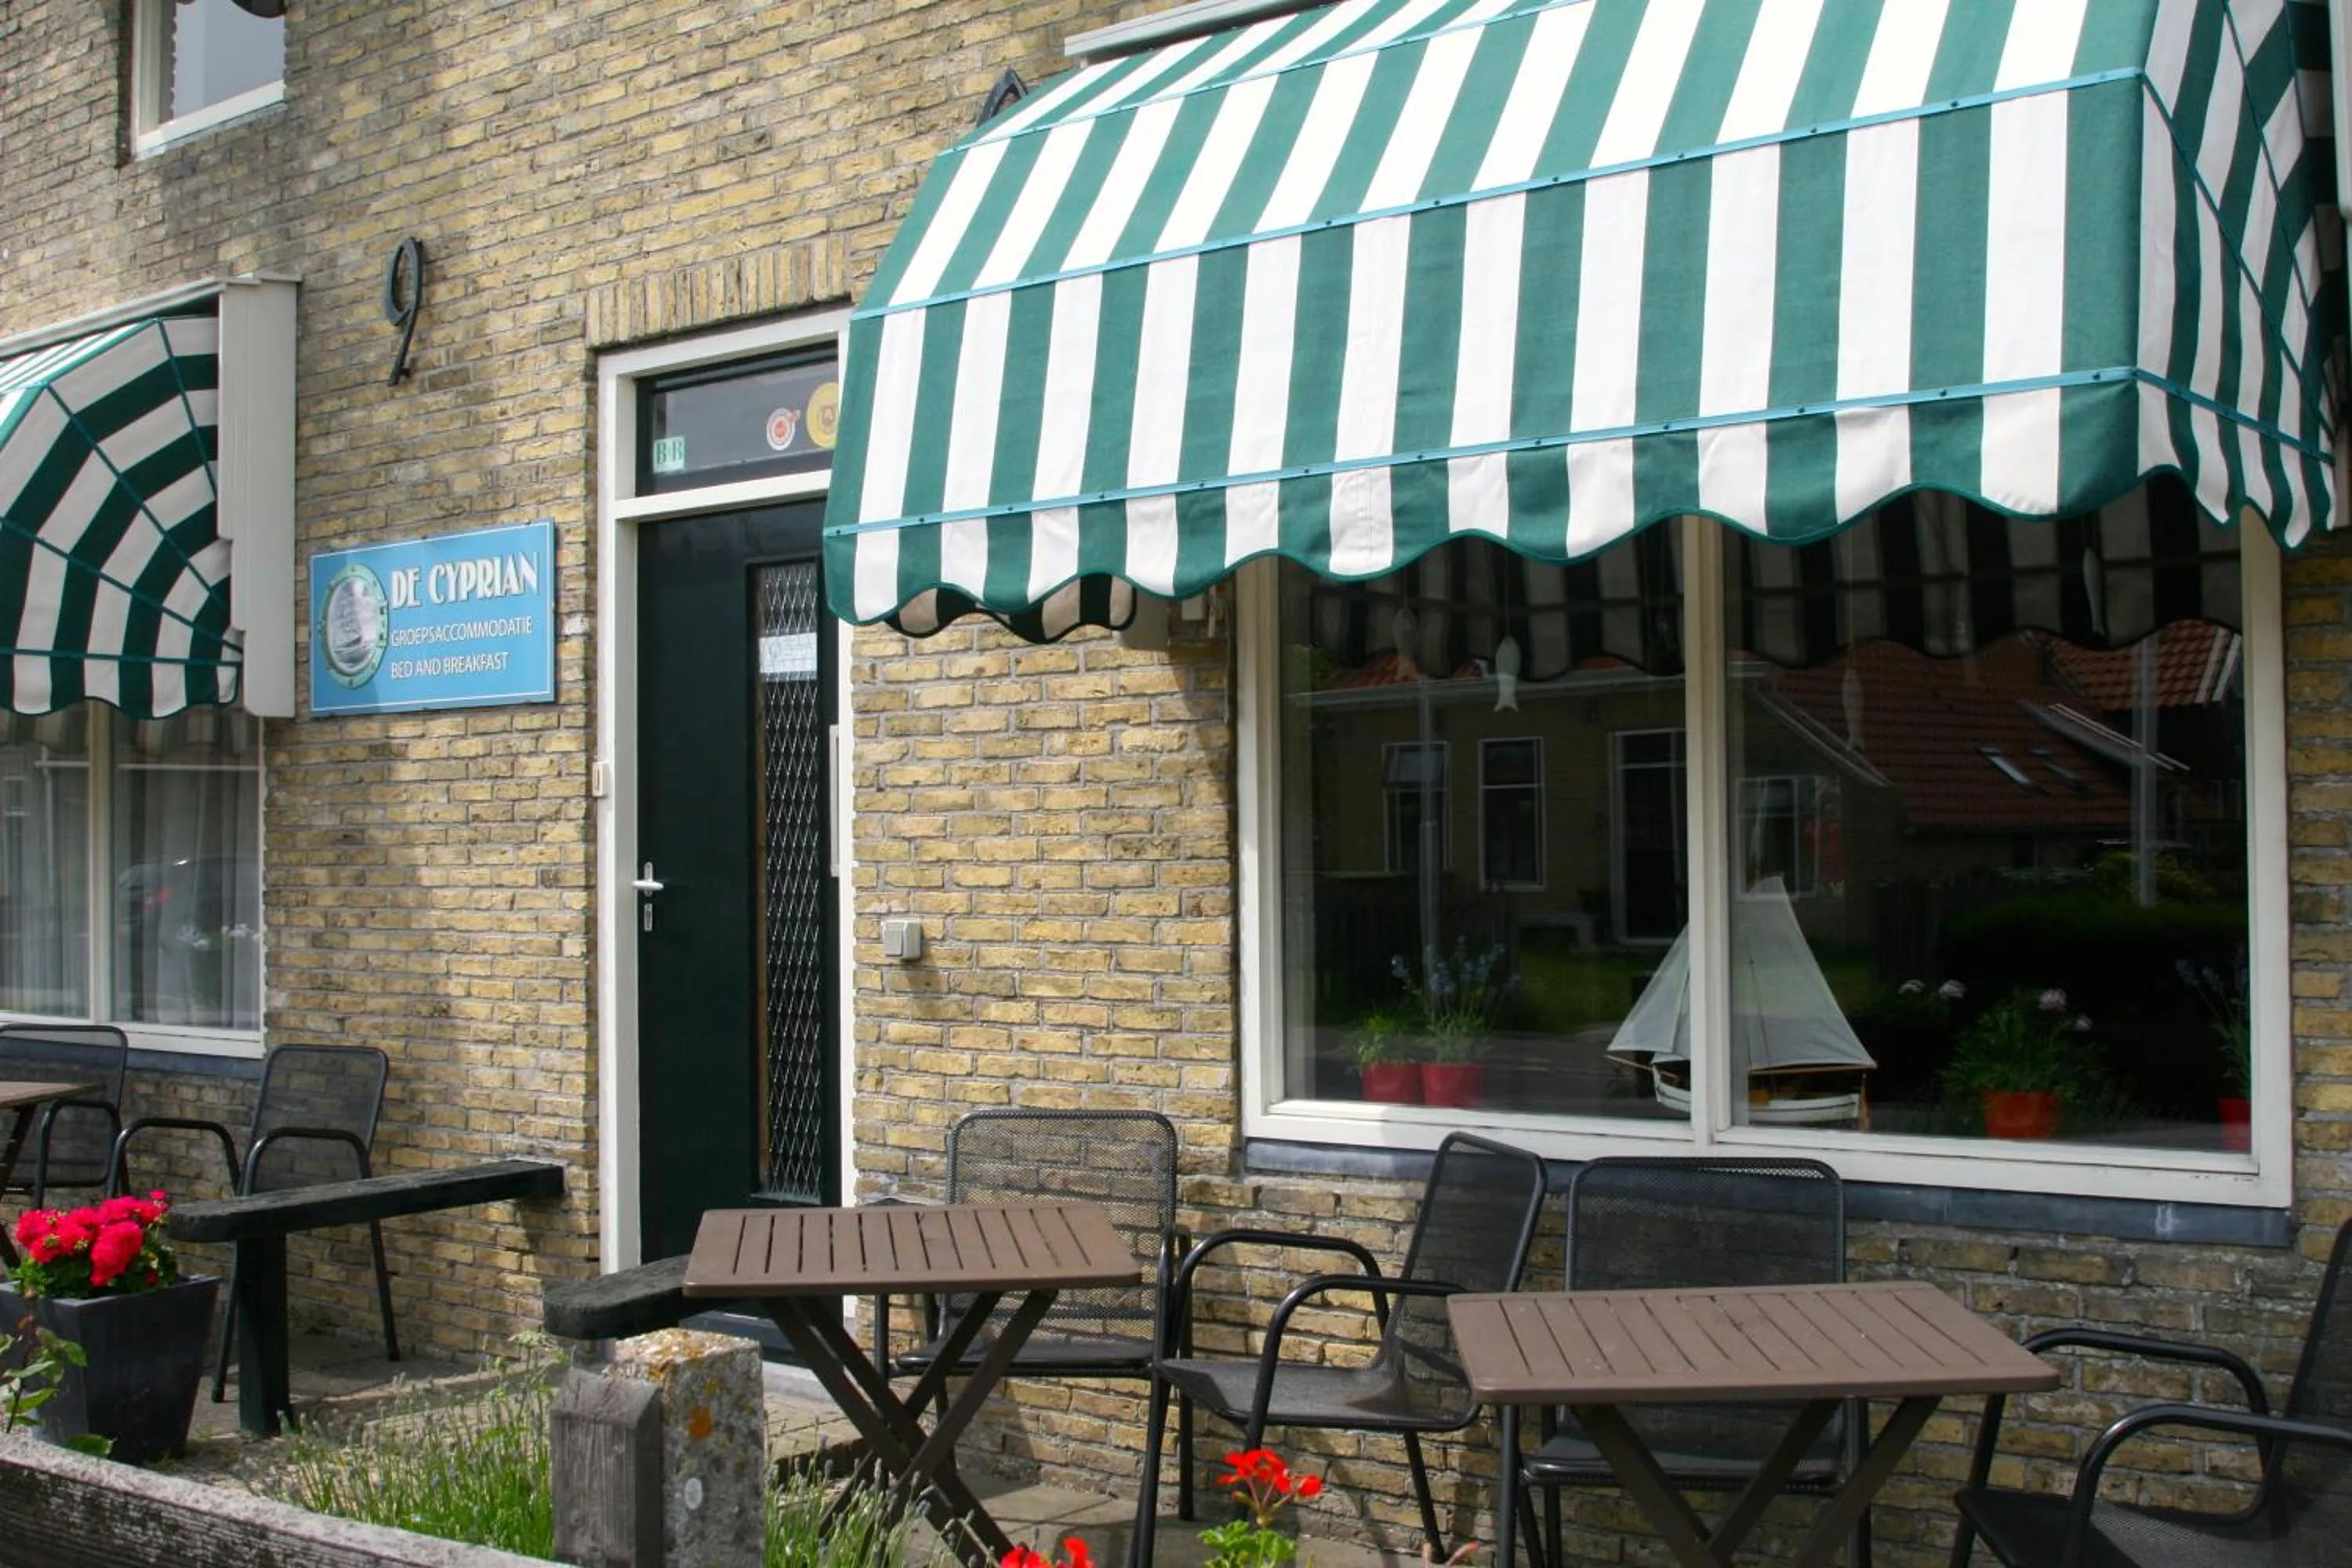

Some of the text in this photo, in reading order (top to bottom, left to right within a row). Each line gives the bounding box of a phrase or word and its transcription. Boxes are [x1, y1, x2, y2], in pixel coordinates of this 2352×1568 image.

[391, 551, 539, 609] DE CYPRIAN
[392, 615, 533, 647] GROEPSACCOMMODATIE
[392, 652, 509, 678] BED AND BREAKFAST
